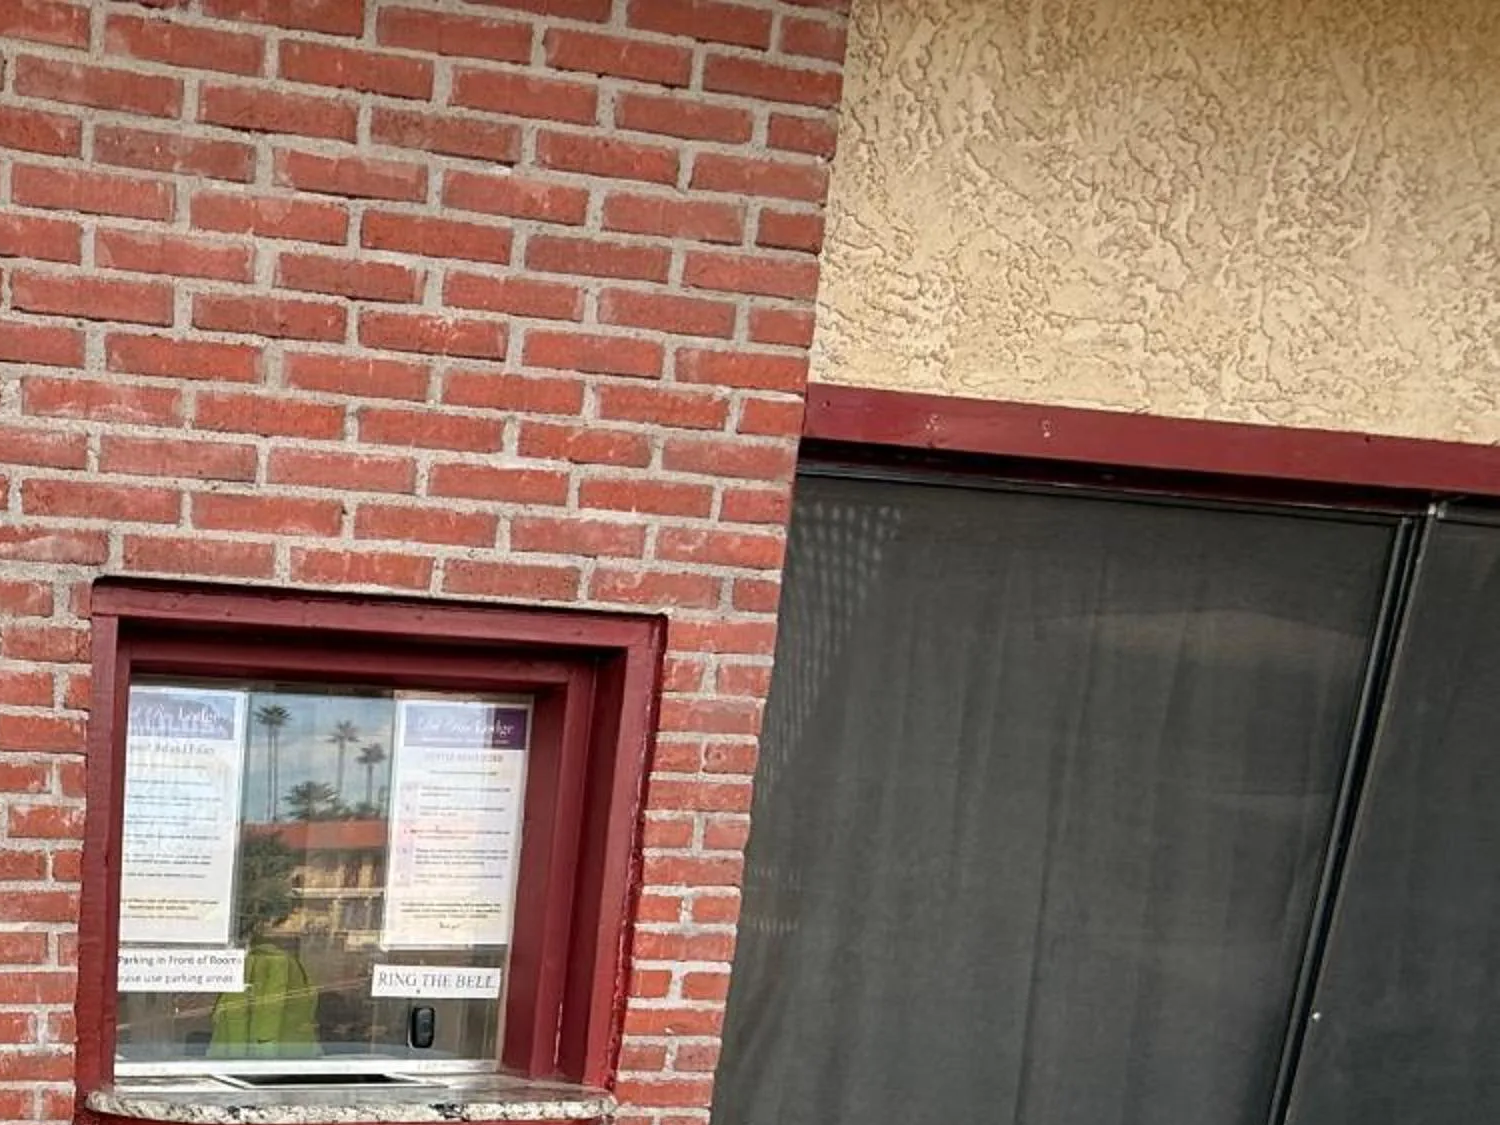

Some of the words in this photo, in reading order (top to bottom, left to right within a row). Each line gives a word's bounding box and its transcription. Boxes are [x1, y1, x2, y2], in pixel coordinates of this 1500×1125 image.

[378, 970, 418, 988] RING
[422, 972, 452, 988] THE
[455, 974, 498, 989] BELL
